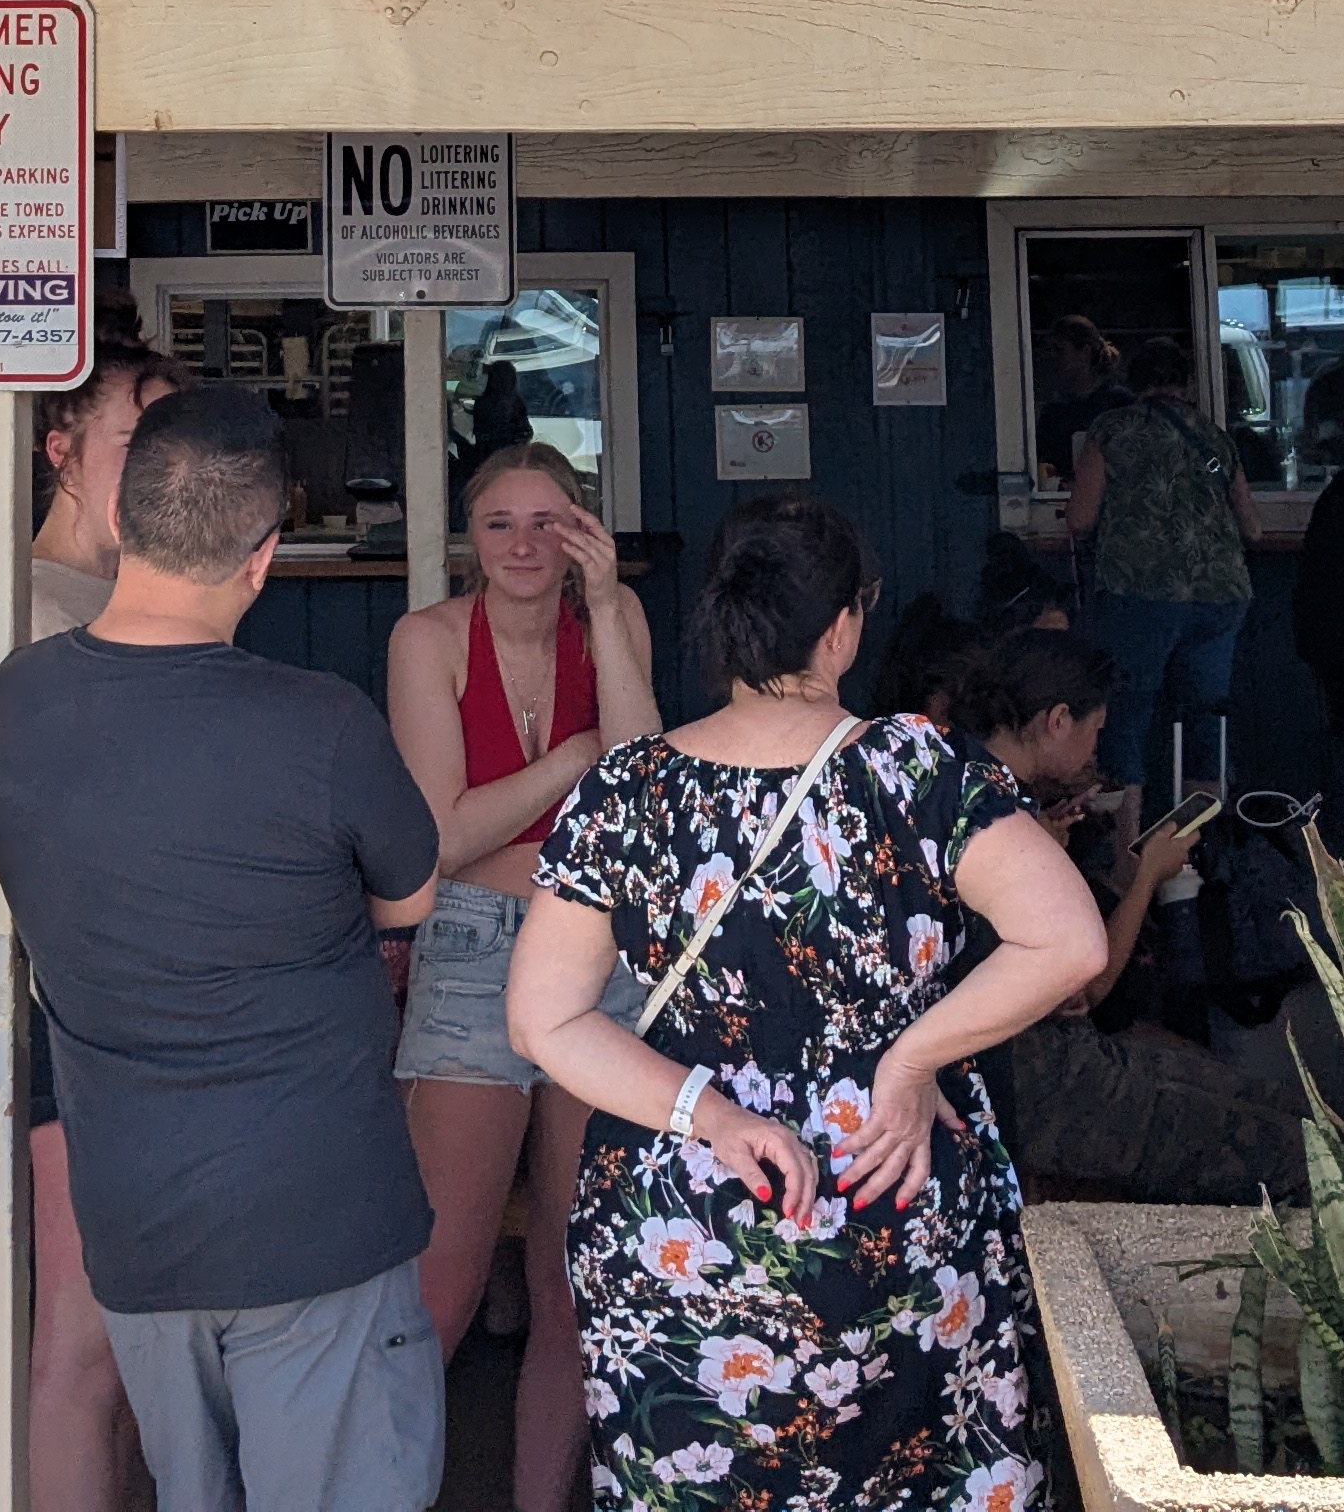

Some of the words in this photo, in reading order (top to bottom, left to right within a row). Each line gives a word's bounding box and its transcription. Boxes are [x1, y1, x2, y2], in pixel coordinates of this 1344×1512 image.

[420, 144, 500, 164] LOITERING
[341, 144, 413, 217] NO
[420, 170, 497, 190] LITTERING
[15, 203, 64, 217] TOWED
[212, 202, 267, 223] Pick
[274, 202, 307, 224] Up
[421, 196, 496, 216] DRINKING
[8, 225, 76, 238] EXPENSE
[341, 225, 357, 240] OF
[361, 225, 428, 240] ALCOHOLIC
[433, 225, 500, 240] BEVERAGES
[376, 252, 439, 266] VIOLATORS
[443, 252, 466, 265] ARE
[362, 269, 412, 282] SUBJECT
[418, 269, 432, 281] TO
[436, 268, 480, 281] ARREST
